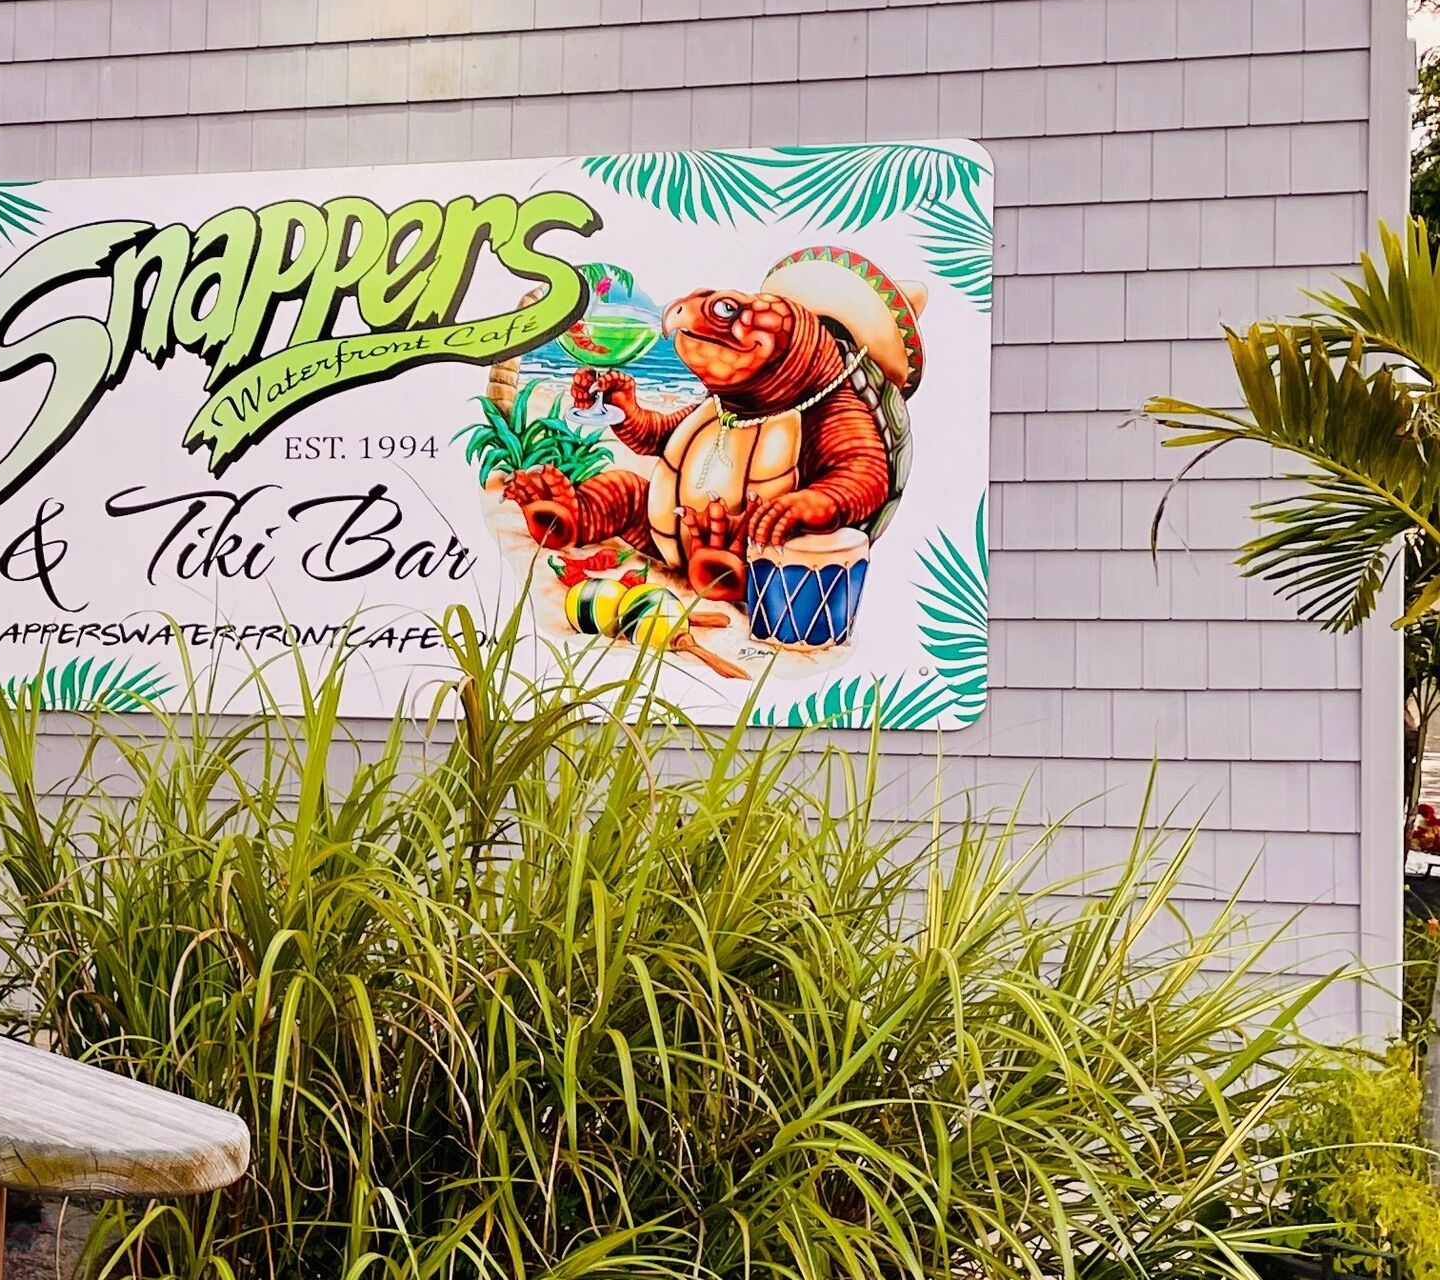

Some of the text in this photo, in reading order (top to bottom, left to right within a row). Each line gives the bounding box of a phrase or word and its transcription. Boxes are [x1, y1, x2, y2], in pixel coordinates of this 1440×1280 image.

[211, 314, 538, 427] Waterfront Café
[284, 435, 440, 460] EST. 1994
[105, 484, 283, 586] Tiki
[287, 483, 478, 583] Bar
